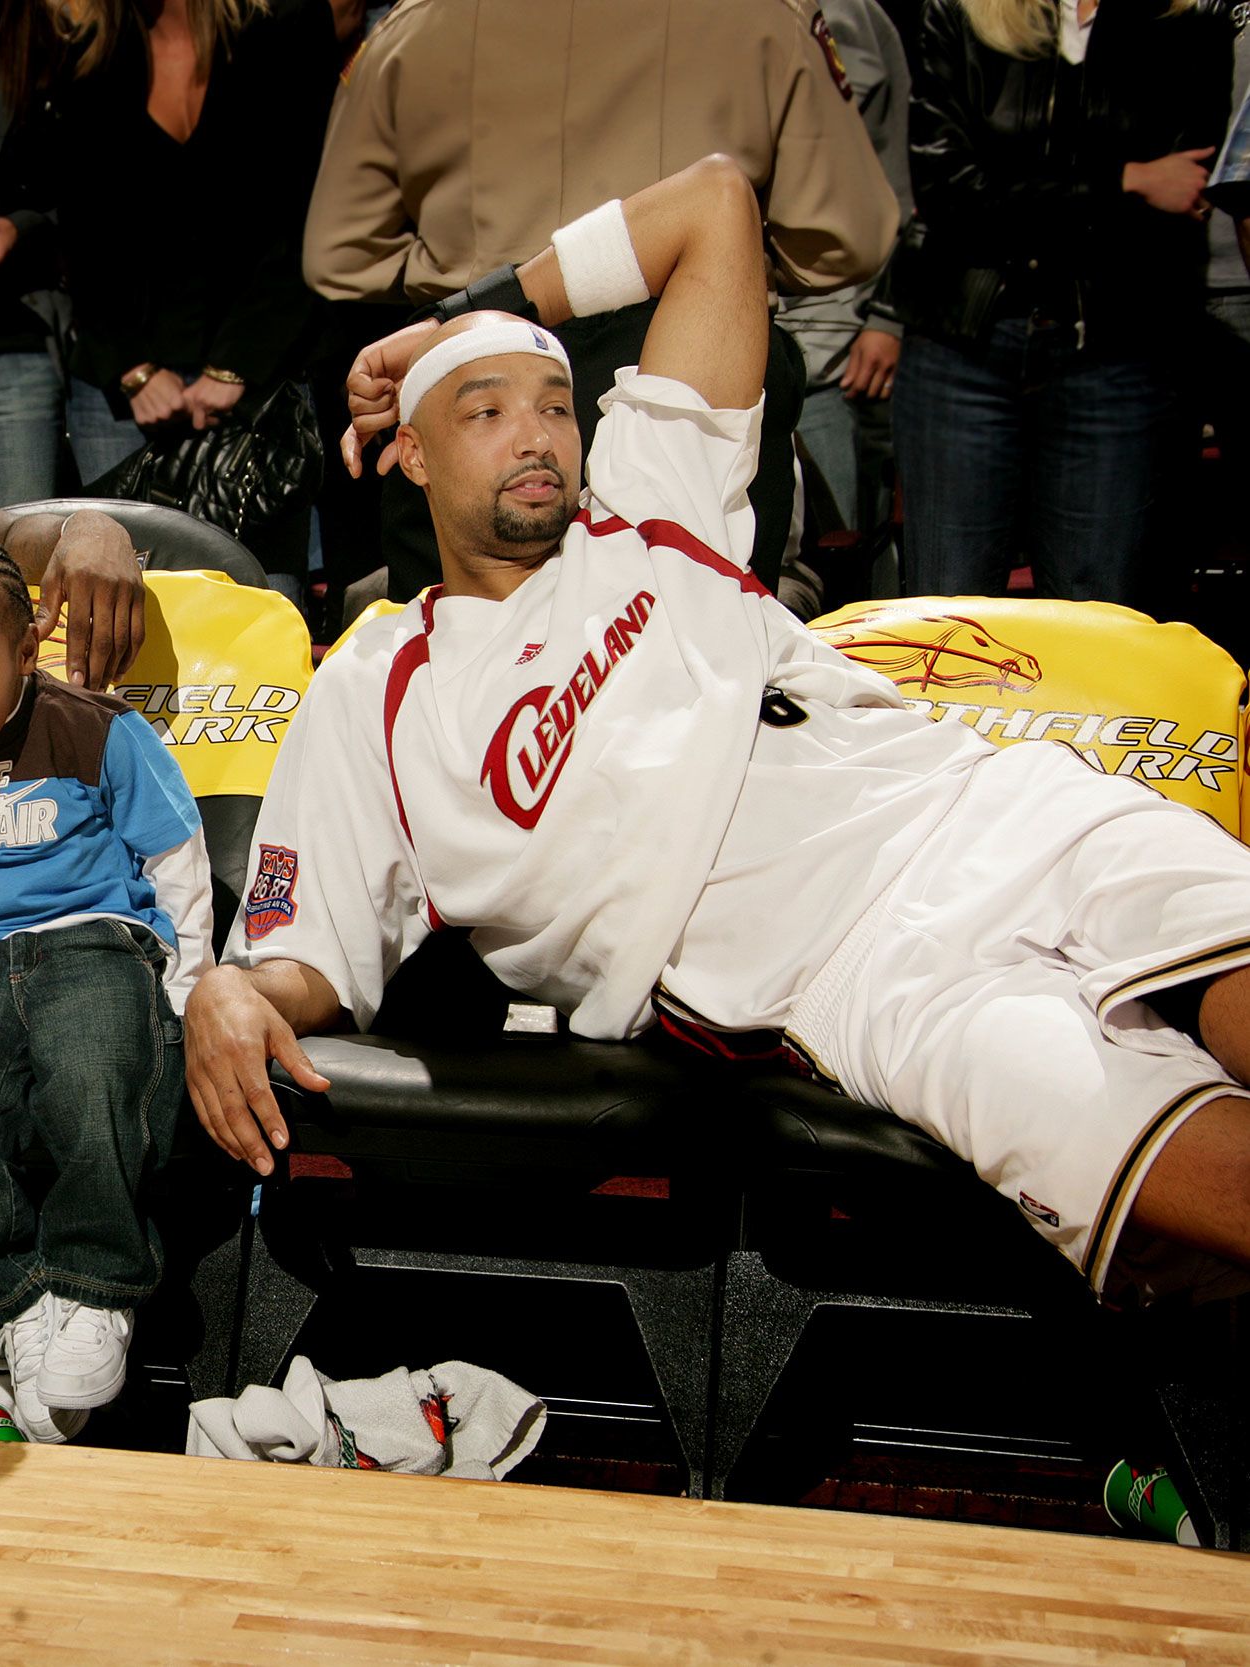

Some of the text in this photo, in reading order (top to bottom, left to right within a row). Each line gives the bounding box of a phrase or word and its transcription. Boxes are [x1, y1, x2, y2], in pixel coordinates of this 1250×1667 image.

[113, 684, 301, 714] FIELD
[480, 590, 656, 832] CLEVELAND
[148, 715, 289, 745] ARK
